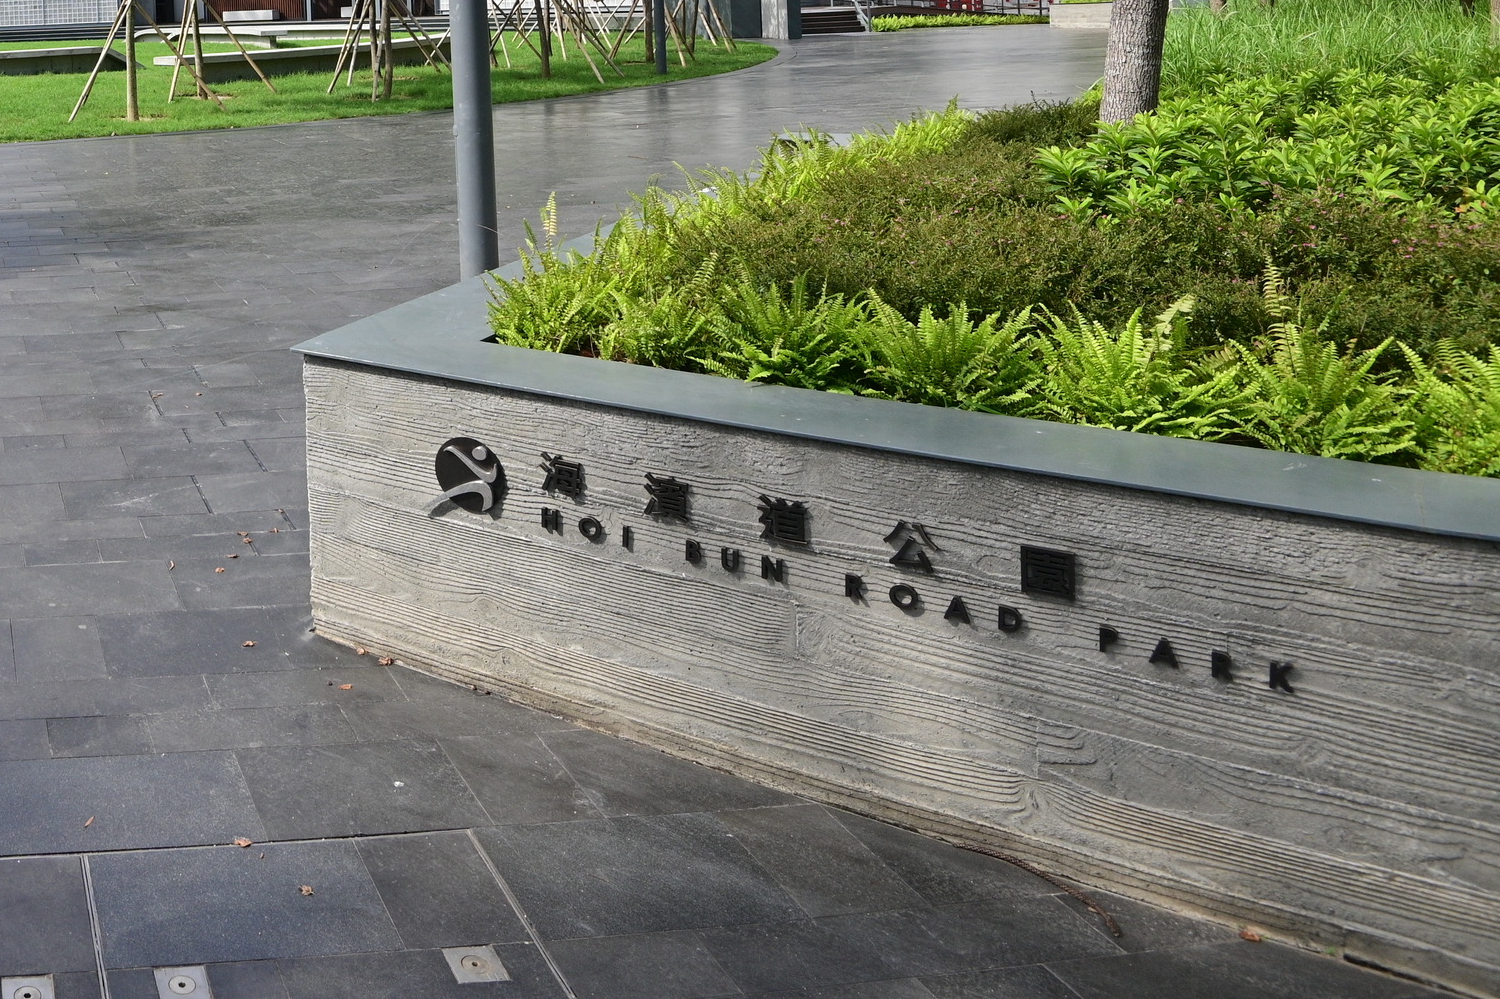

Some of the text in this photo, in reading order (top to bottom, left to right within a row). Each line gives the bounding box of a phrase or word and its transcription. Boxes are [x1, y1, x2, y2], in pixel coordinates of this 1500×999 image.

[540, 451, 1076, 601] 海濱道公園
[540, 506, 1295, 694] HOI BUN ROAD PARK
